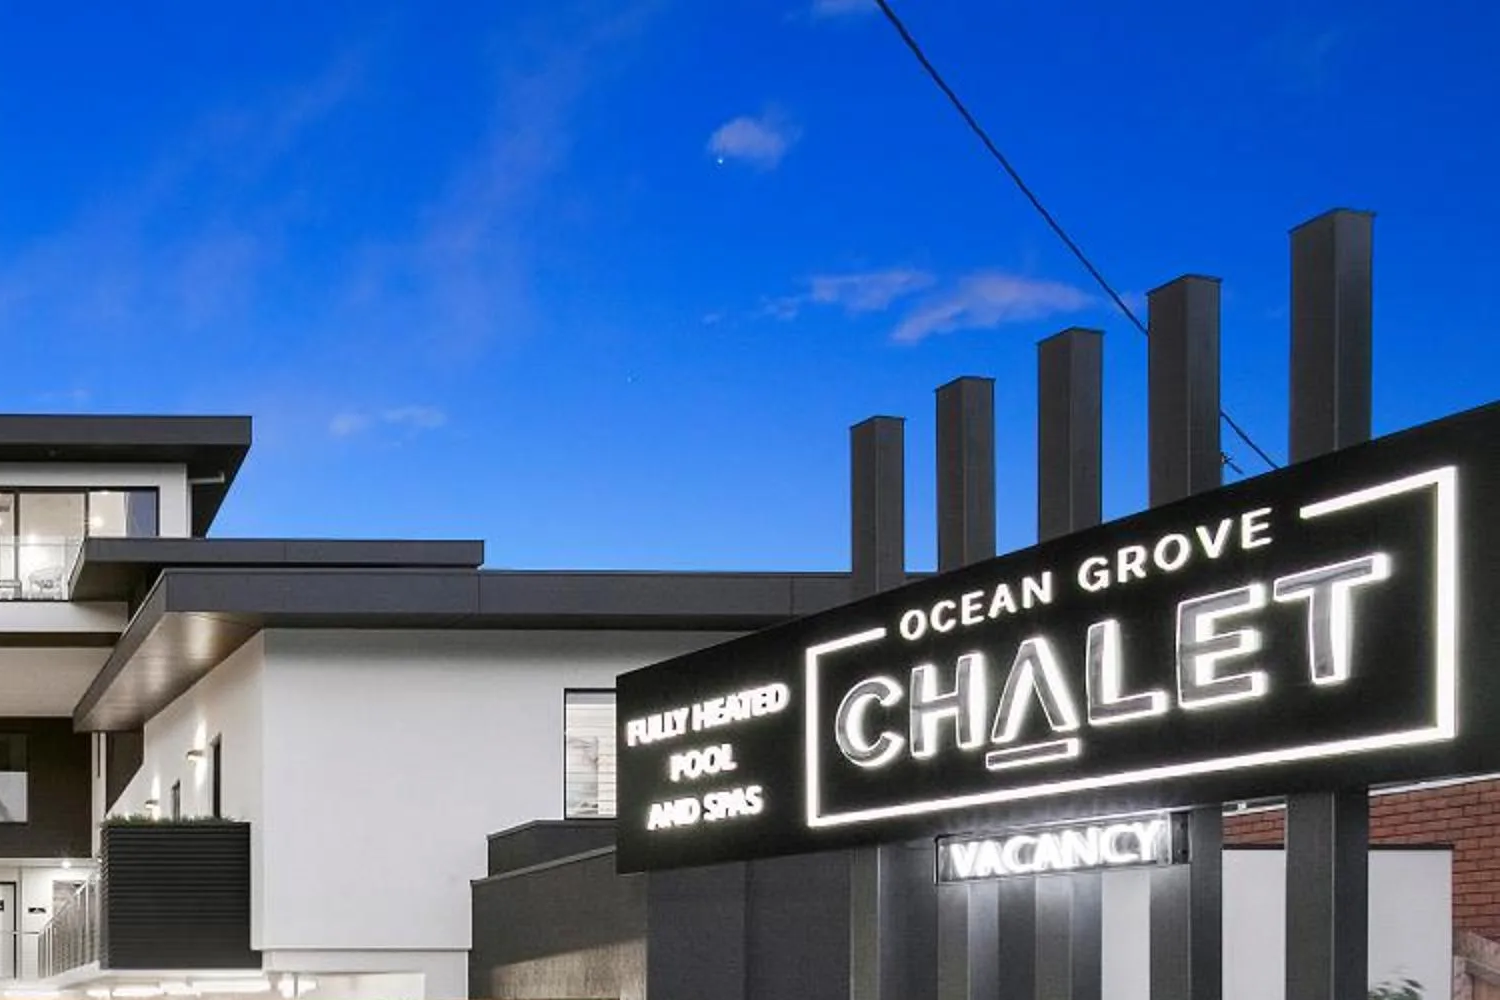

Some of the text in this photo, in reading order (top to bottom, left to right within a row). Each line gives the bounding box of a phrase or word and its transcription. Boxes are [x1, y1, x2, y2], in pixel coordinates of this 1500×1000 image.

[899, 506, 1273, 643] OCEAN GROVE
[834, 550, 1392, 769] CHALET
[626, 683, 790, 747] FULLY HEATED
[669, 743, 738, 783] POOL
[647, 785, 765, 831] AND SPAS
[950, 819, 1166, 878] VACANCY
